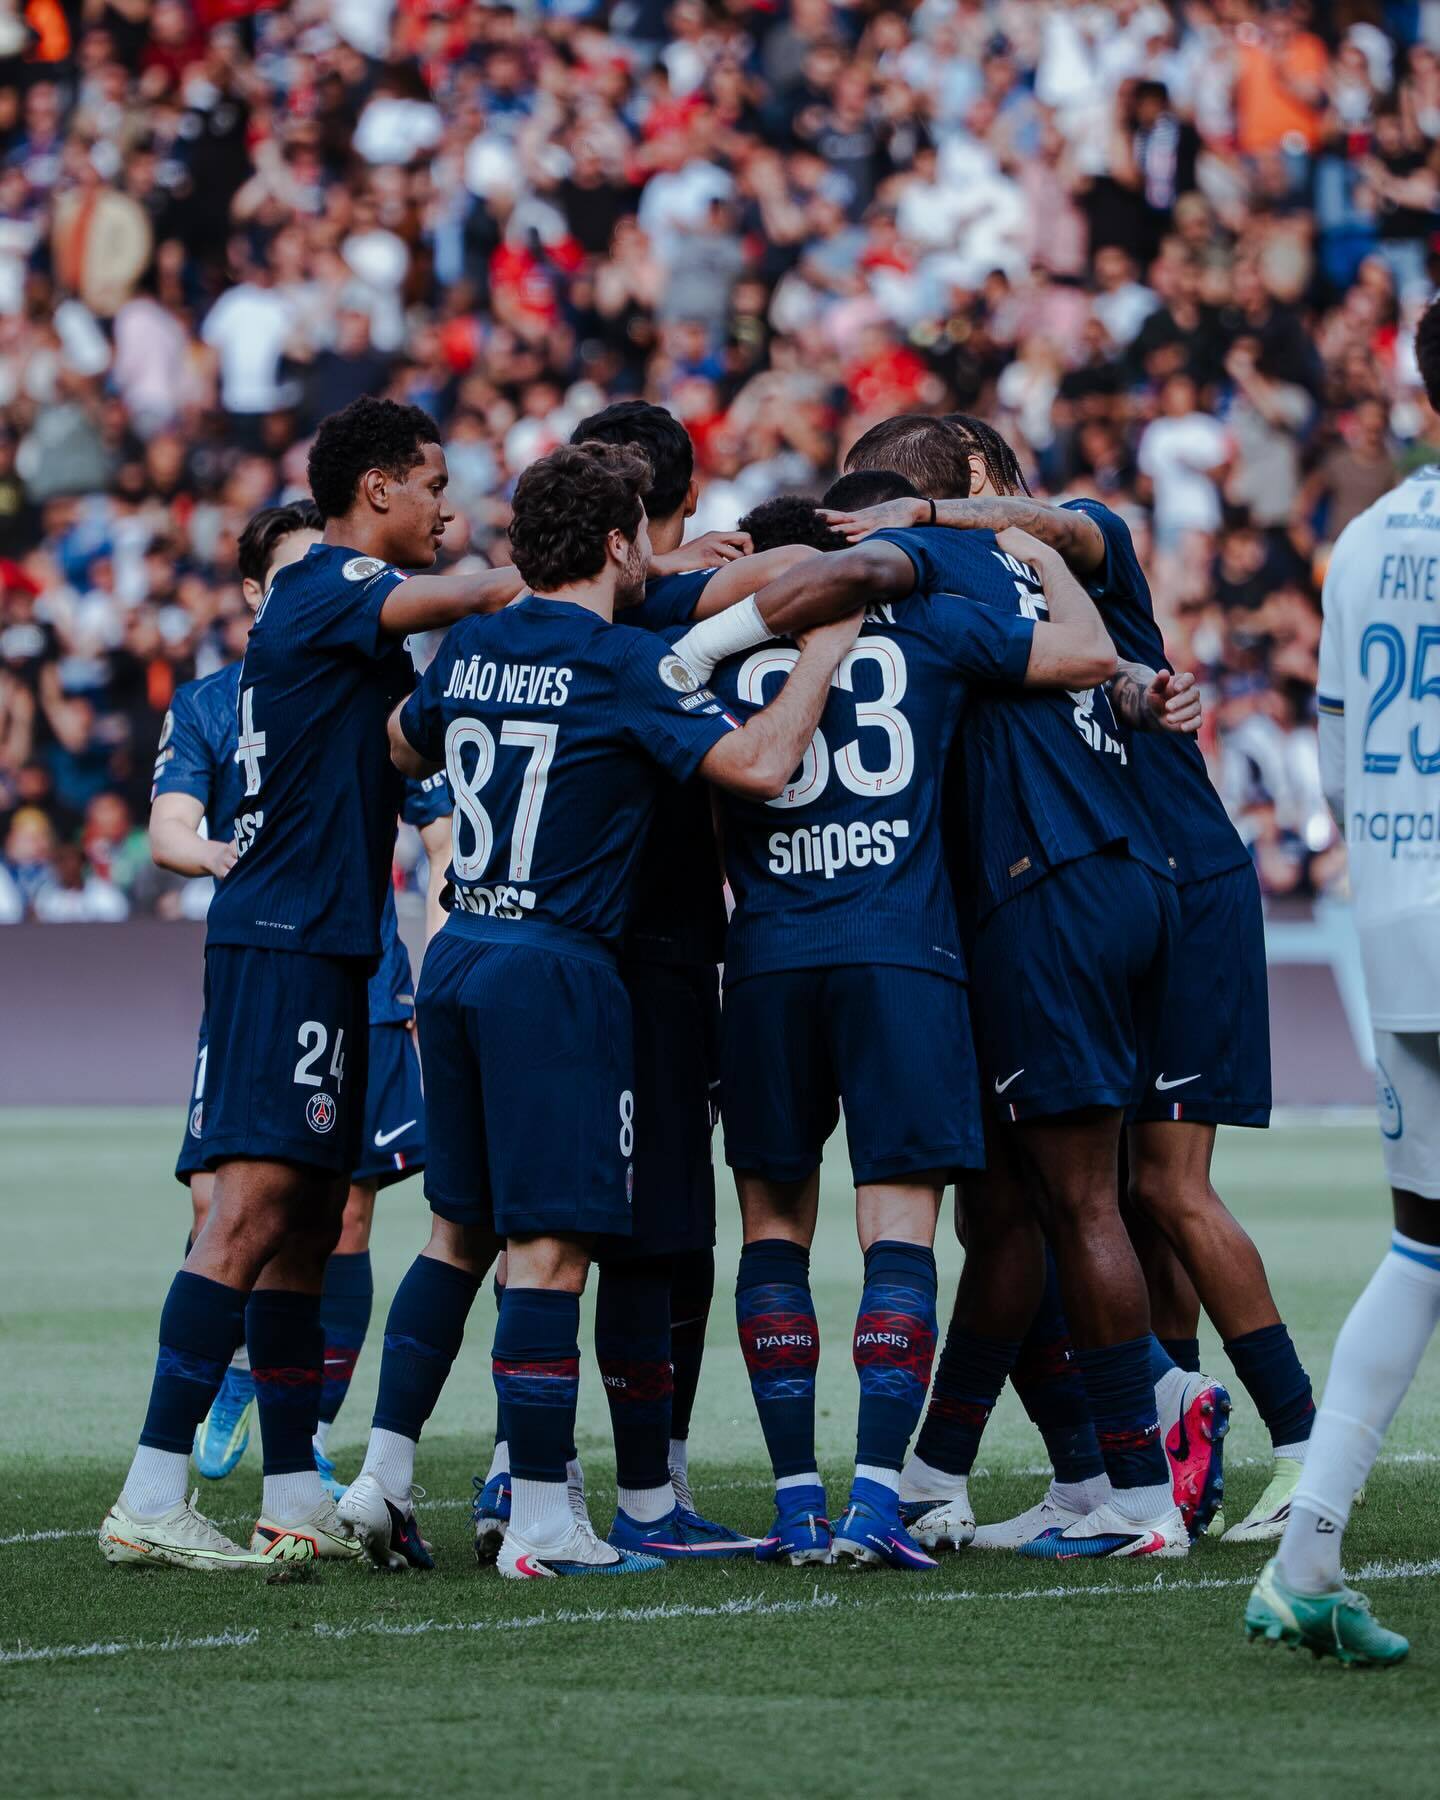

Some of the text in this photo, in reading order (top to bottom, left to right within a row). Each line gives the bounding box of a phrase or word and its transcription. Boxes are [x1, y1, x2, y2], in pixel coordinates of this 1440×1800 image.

[1378, 554, 1438, 602] FAYE
[443, 654, 573, 707] JOÃO NEVES
[1360, 622, 1440, 775] 25
[444, 716, 560, 883] 87
[768, 819, 898, 880] snipes
[1351, 811, 1440, 860] napa
[293, 1020, 345, 1095] 24
[312, 1094, 333, 1108] PARIS
[619, 1089, 634, 1157] 8
[756, 1334, 813, 1350] PARIS
[856, 1332, 909, 1349] PARIS
[603, 1375, 627, 1388] RIS
